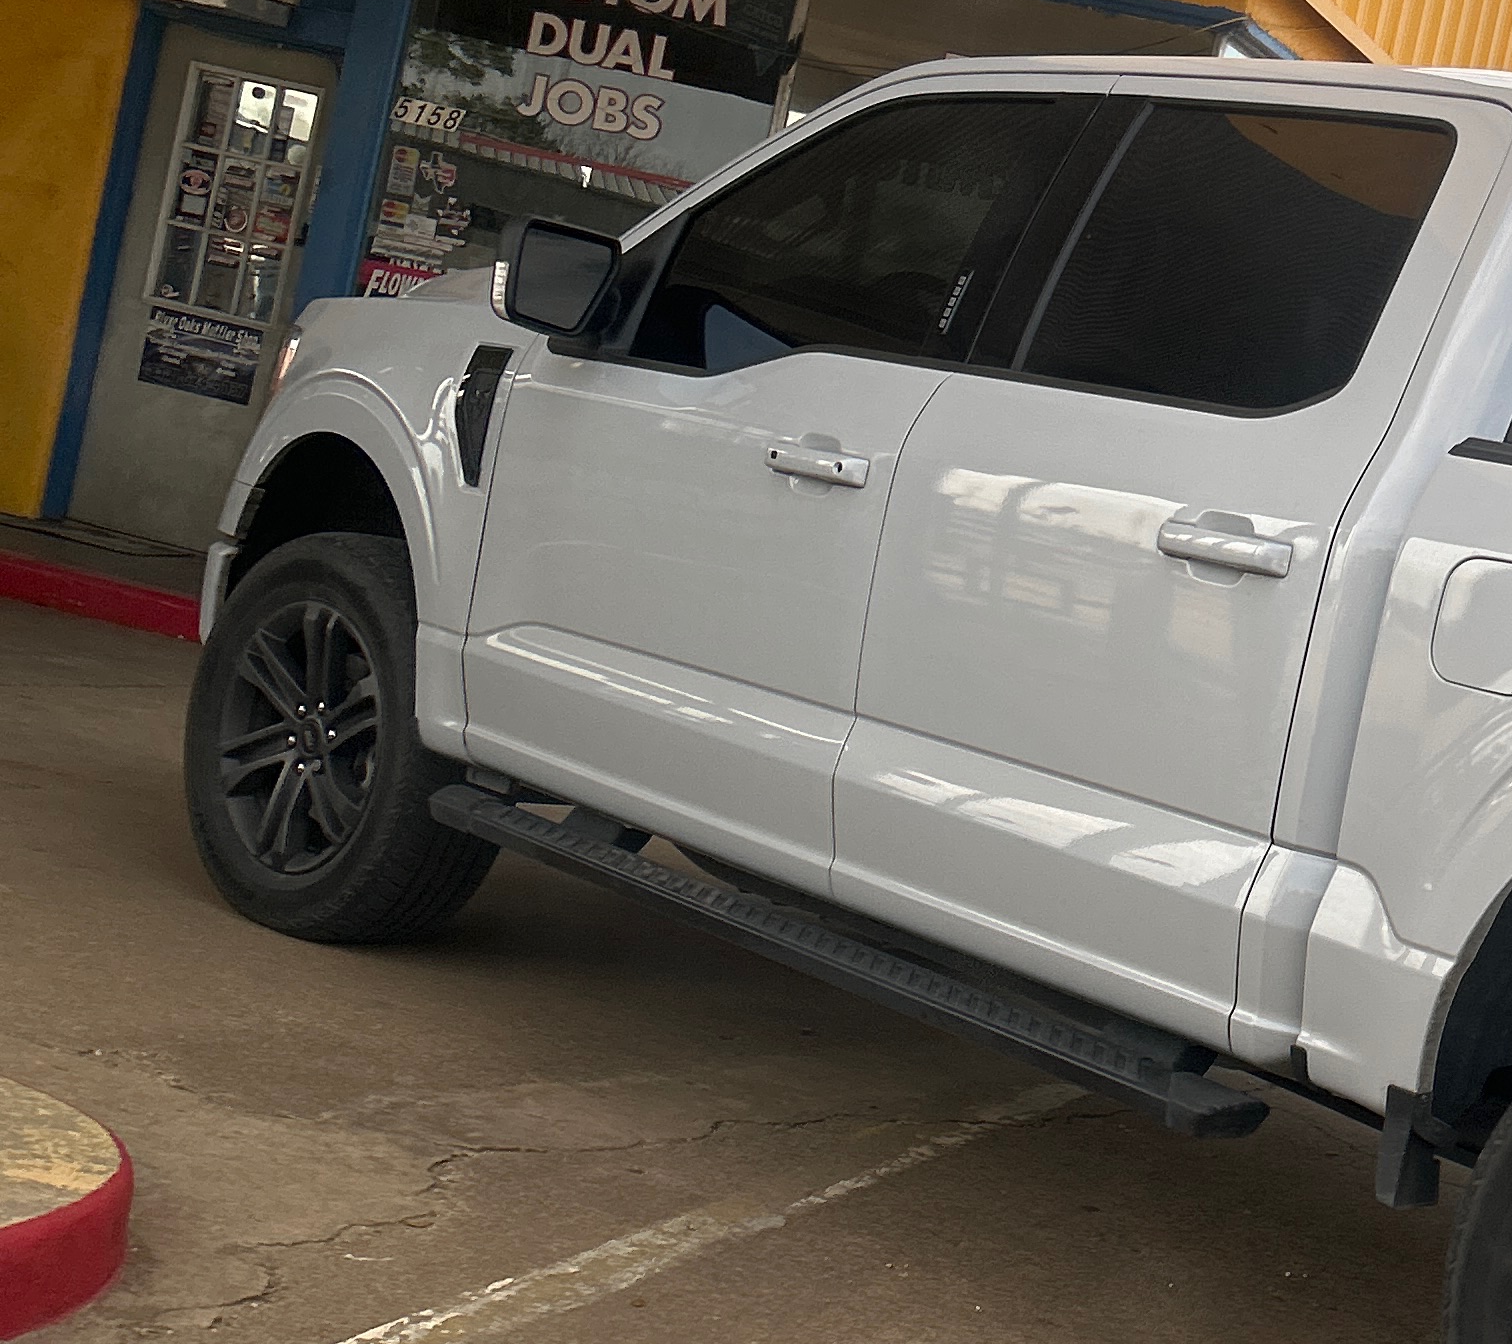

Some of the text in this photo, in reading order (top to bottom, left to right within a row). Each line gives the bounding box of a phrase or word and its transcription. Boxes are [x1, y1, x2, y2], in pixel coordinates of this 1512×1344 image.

[526, 11, 676, 82] DUAL
[394, 98, 461, 130] 5158
[516, 72, 666, 141] JOBS
